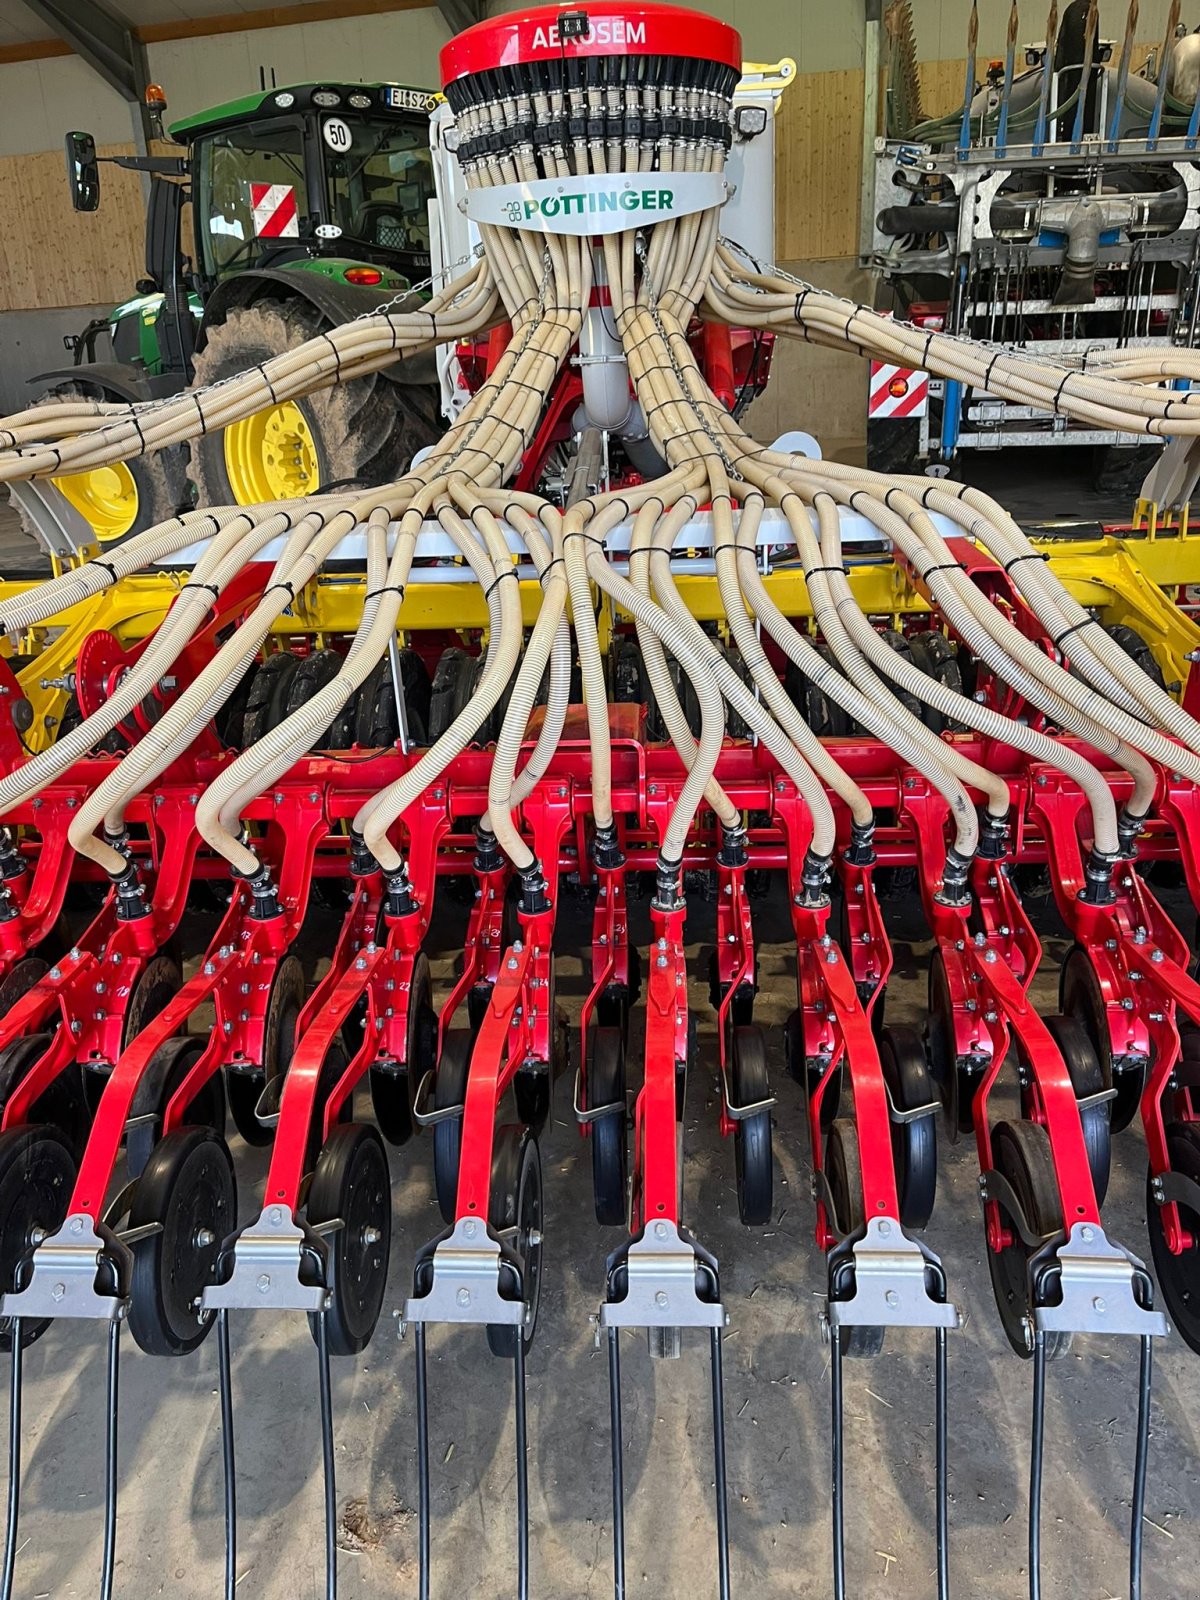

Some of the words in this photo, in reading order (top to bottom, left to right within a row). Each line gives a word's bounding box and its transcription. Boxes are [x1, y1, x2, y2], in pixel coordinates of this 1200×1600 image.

[392, 89, 405, 105] EI
[411, 94, 430, 109] S2
[329, 124, 347, 146] 50
[523, 190, 674, 220] PÖTTINGER
[399, 982, 411, 992] 22
